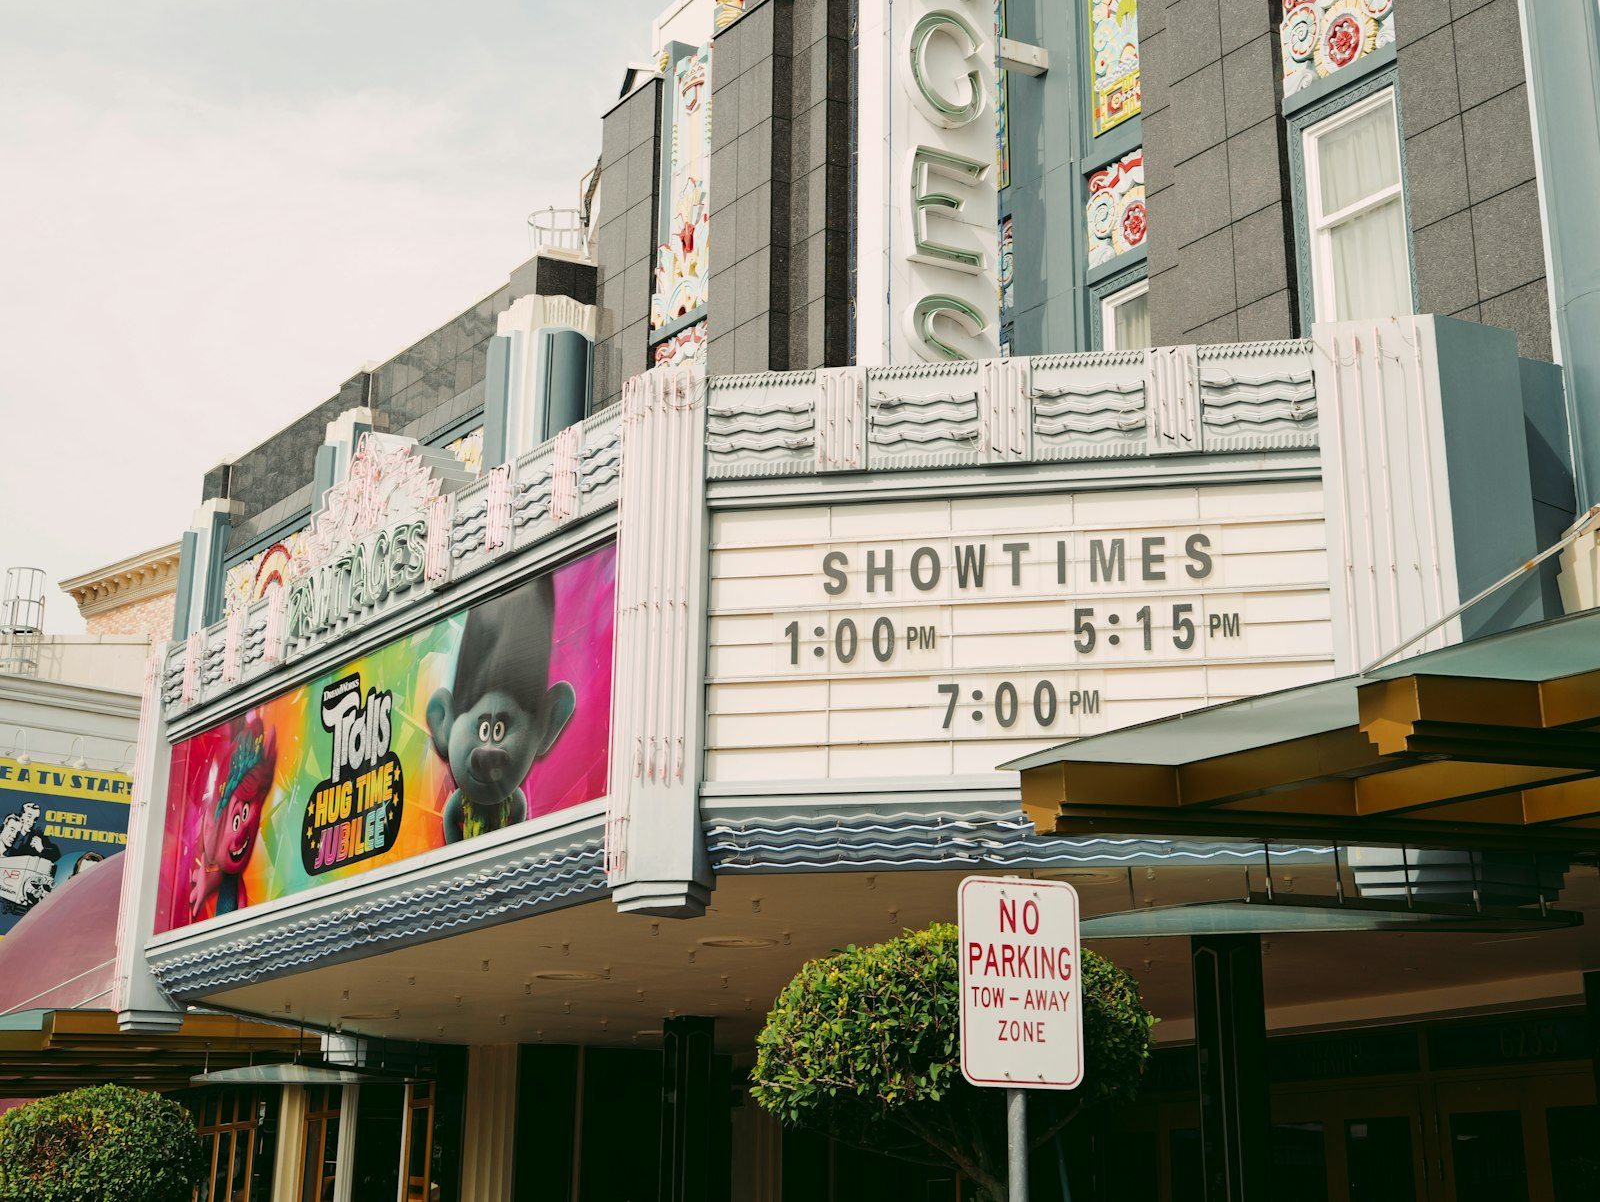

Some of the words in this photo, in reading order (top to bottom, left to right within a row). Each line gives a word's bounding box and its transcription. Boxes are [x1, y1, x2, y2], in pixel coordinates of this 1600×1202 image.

[822, 533, 1213, 596] SHOWTIMES
[322, 691, 392, 783] Trolls
[18, 768, 30, 783] A
[37, 770, 66, 787] TV
[70, 774, 134, 796] STAR!
[314, 780, 352, 828] HUG
[356, 761, 394, 813] TIME
[43, 825, 128, 845] AUDITIONS
[45, 810, 88, 826] OPEN
[314, 804, 386, 869] JUBILEE
[1000, 898, 1039, 935] NO
[969, 942, 1072, 981] PARKING
[998, 1020, 1046, 1043] ZONE
